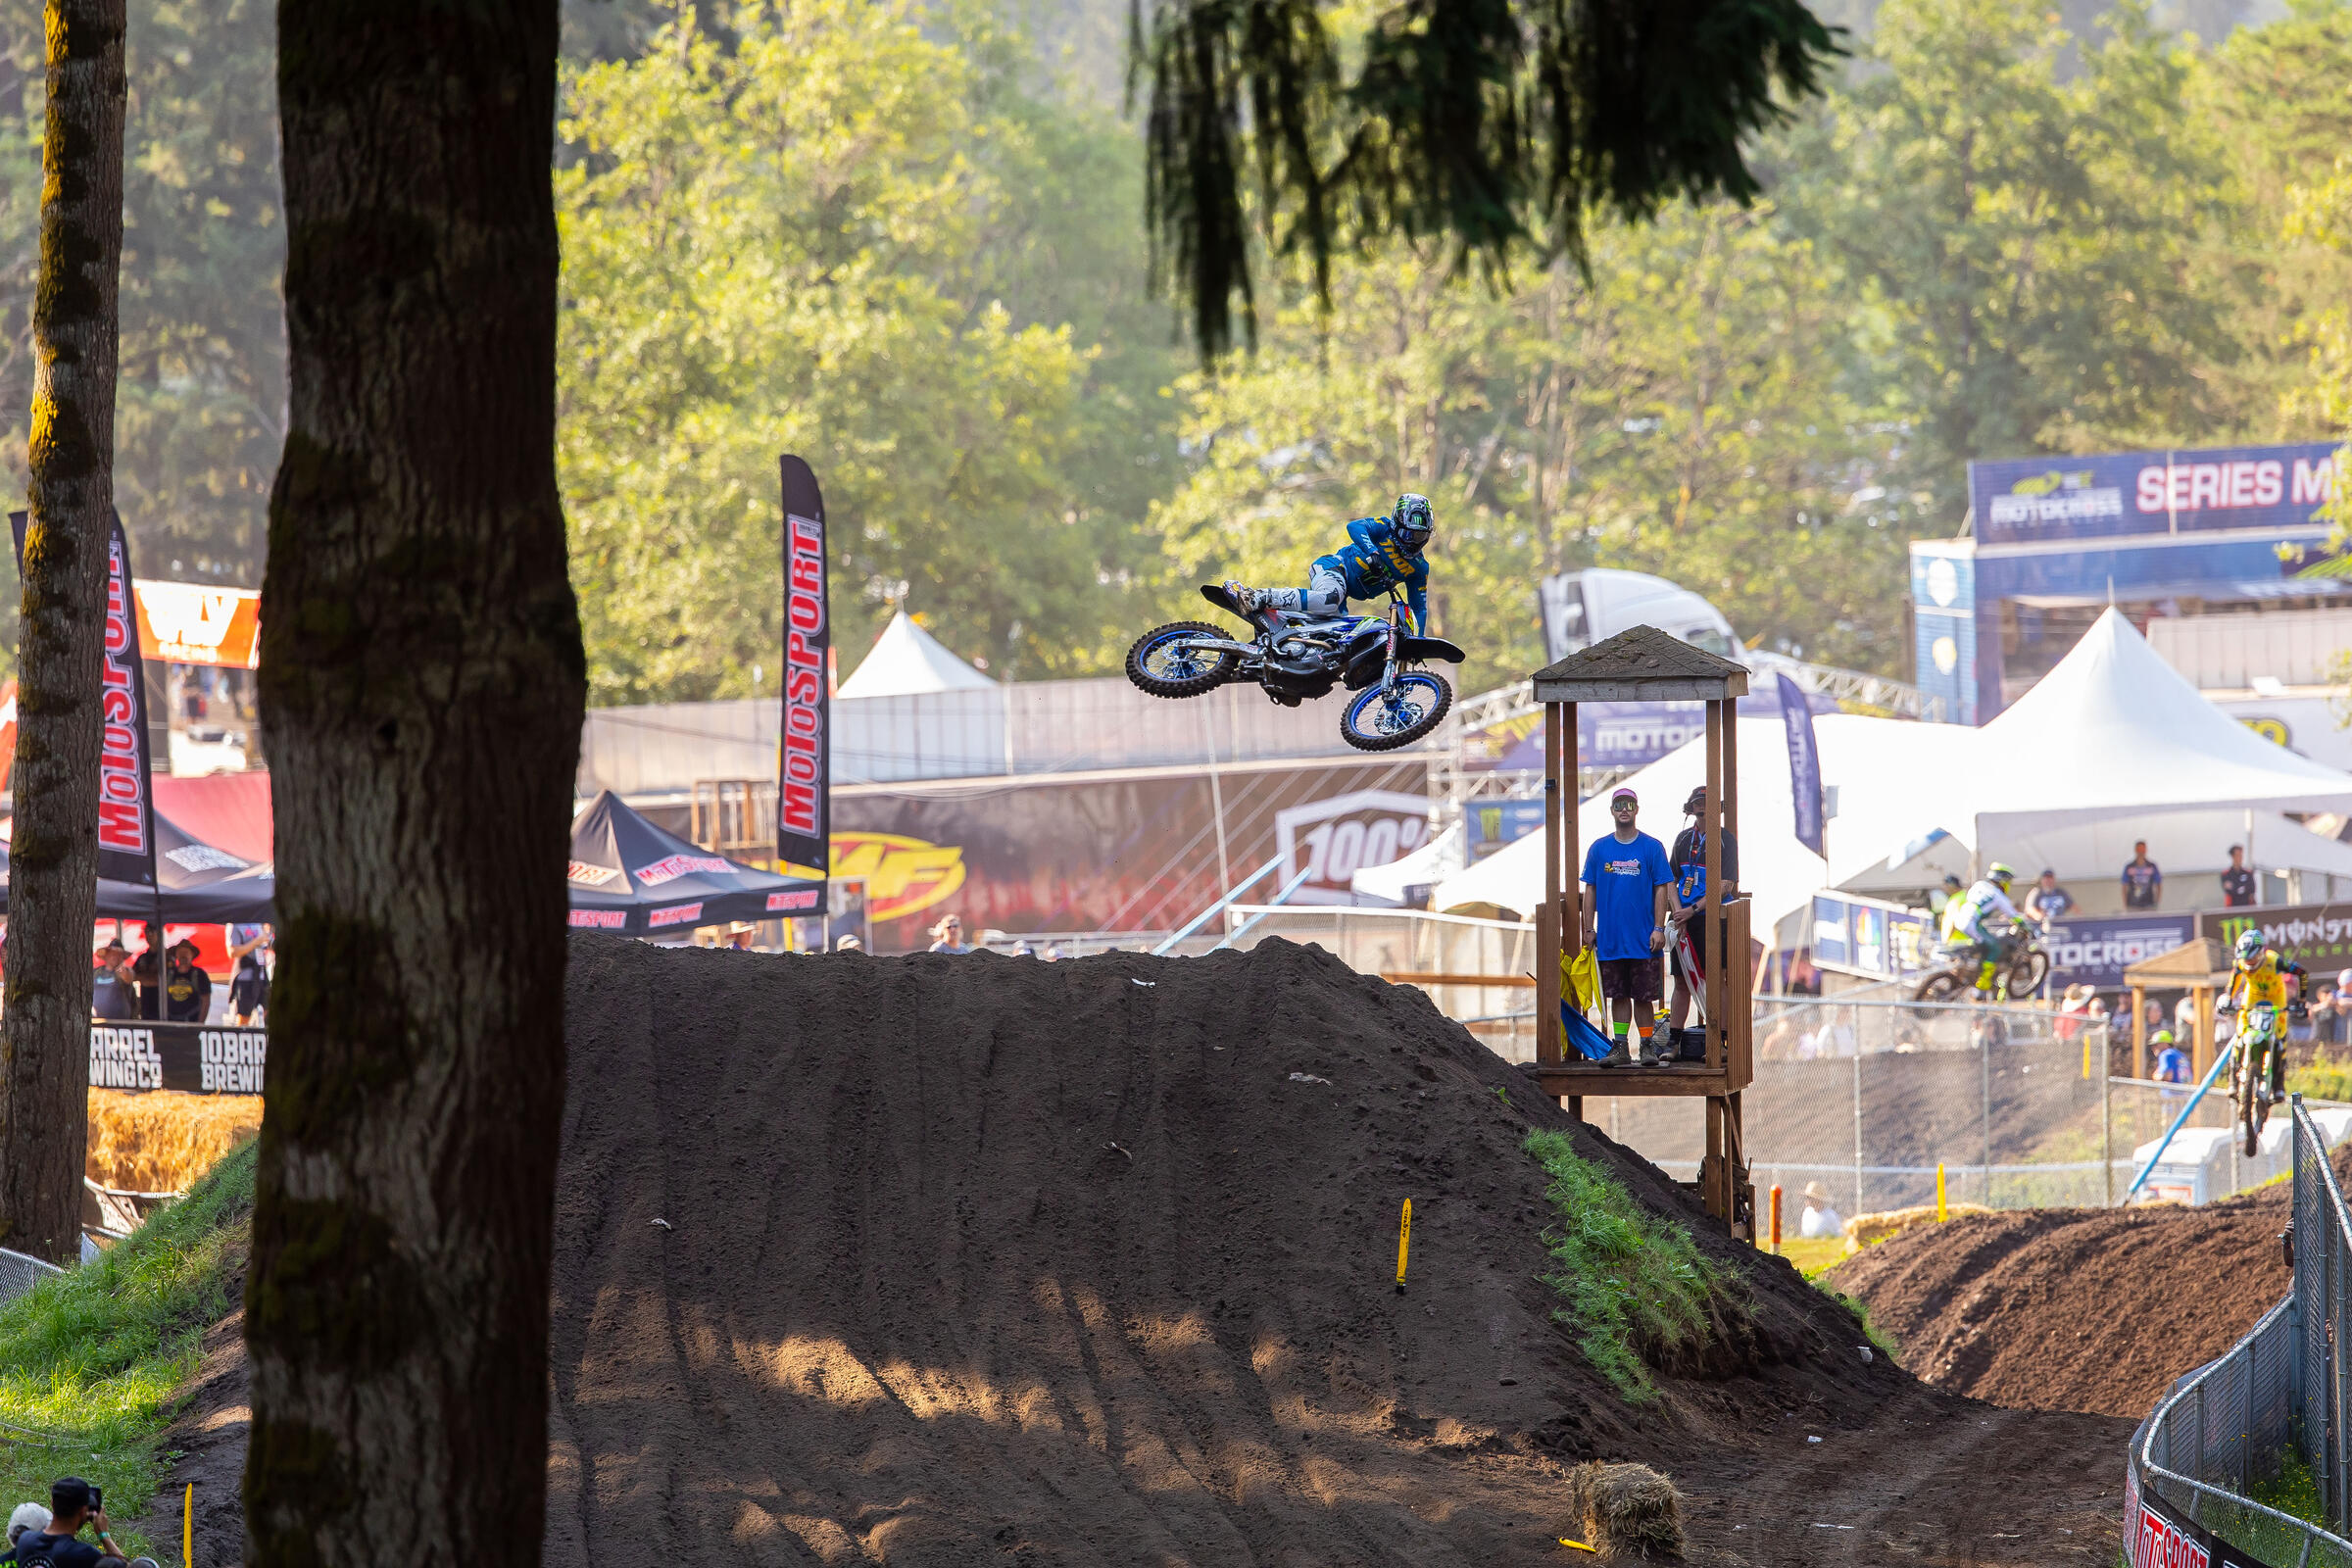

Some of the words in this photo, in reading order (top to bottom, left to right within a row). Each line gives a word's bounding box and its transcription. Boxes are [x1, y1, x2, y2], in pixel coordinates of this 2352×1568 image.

[2136, 461, 2283, 513] SERIES
[1379, 537, 1416, 577] THOR
[782, 517, 824, 837] MOTOSPORT
[568, 909, 627, 929] OTOSPORT
[2048, 938, 2184, 967] TOCROSS
[90, 1027, 162, 1061] ARREL
[199, 1031, 222, 1063] 10
[222, 1032, 267, 1065] BAR
[89, 1058, 136, 1087] WING
